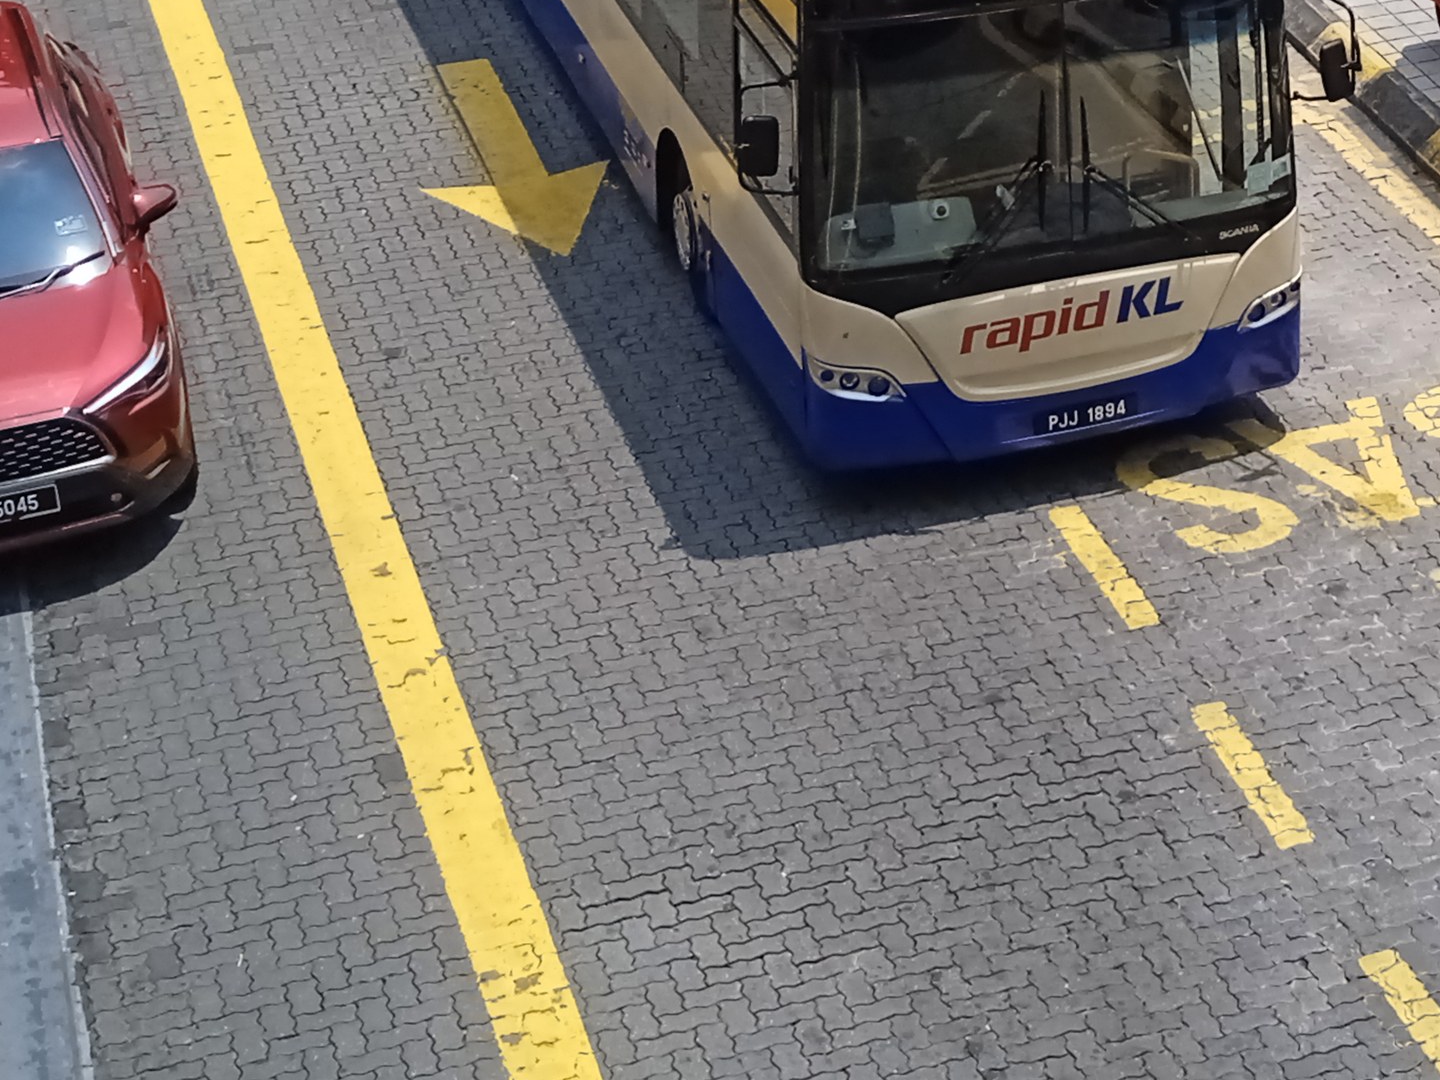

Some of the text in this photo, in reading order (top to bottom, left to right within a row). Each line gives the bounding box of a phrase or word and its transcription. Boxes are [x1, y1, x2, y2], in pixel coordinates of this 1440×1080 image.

[1219, 223, 1259, 240] SCANIA
[1048, 399, 1126, 431] PJJ 1894
